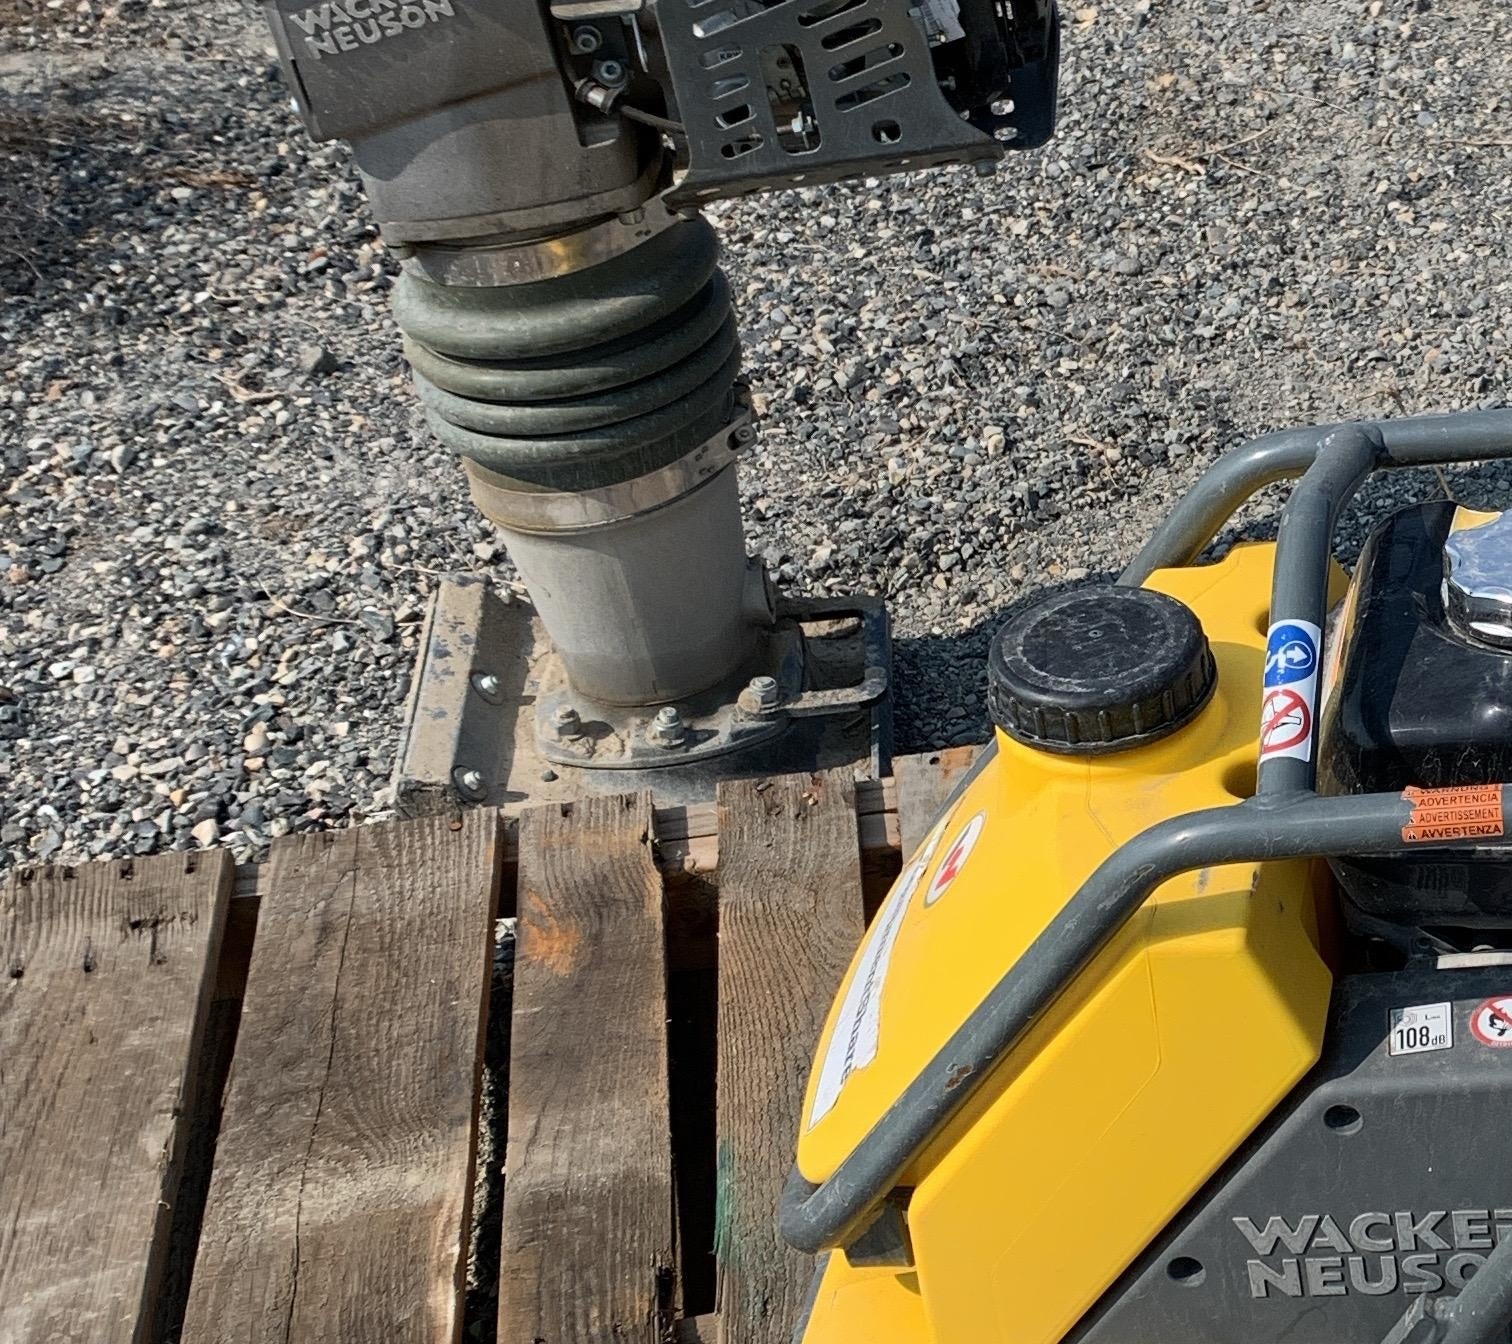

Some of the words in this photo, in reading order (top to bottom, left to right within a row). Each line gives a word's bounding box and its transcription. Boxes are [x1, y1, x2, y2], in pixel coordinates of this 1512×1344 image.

[1418, 793, 1499, 807] ADVERTENCIA
[1419, 807, 1500, 824] ADVERTISSEMENT
[1421, 824, 1502, 838] AVVERTENZA
